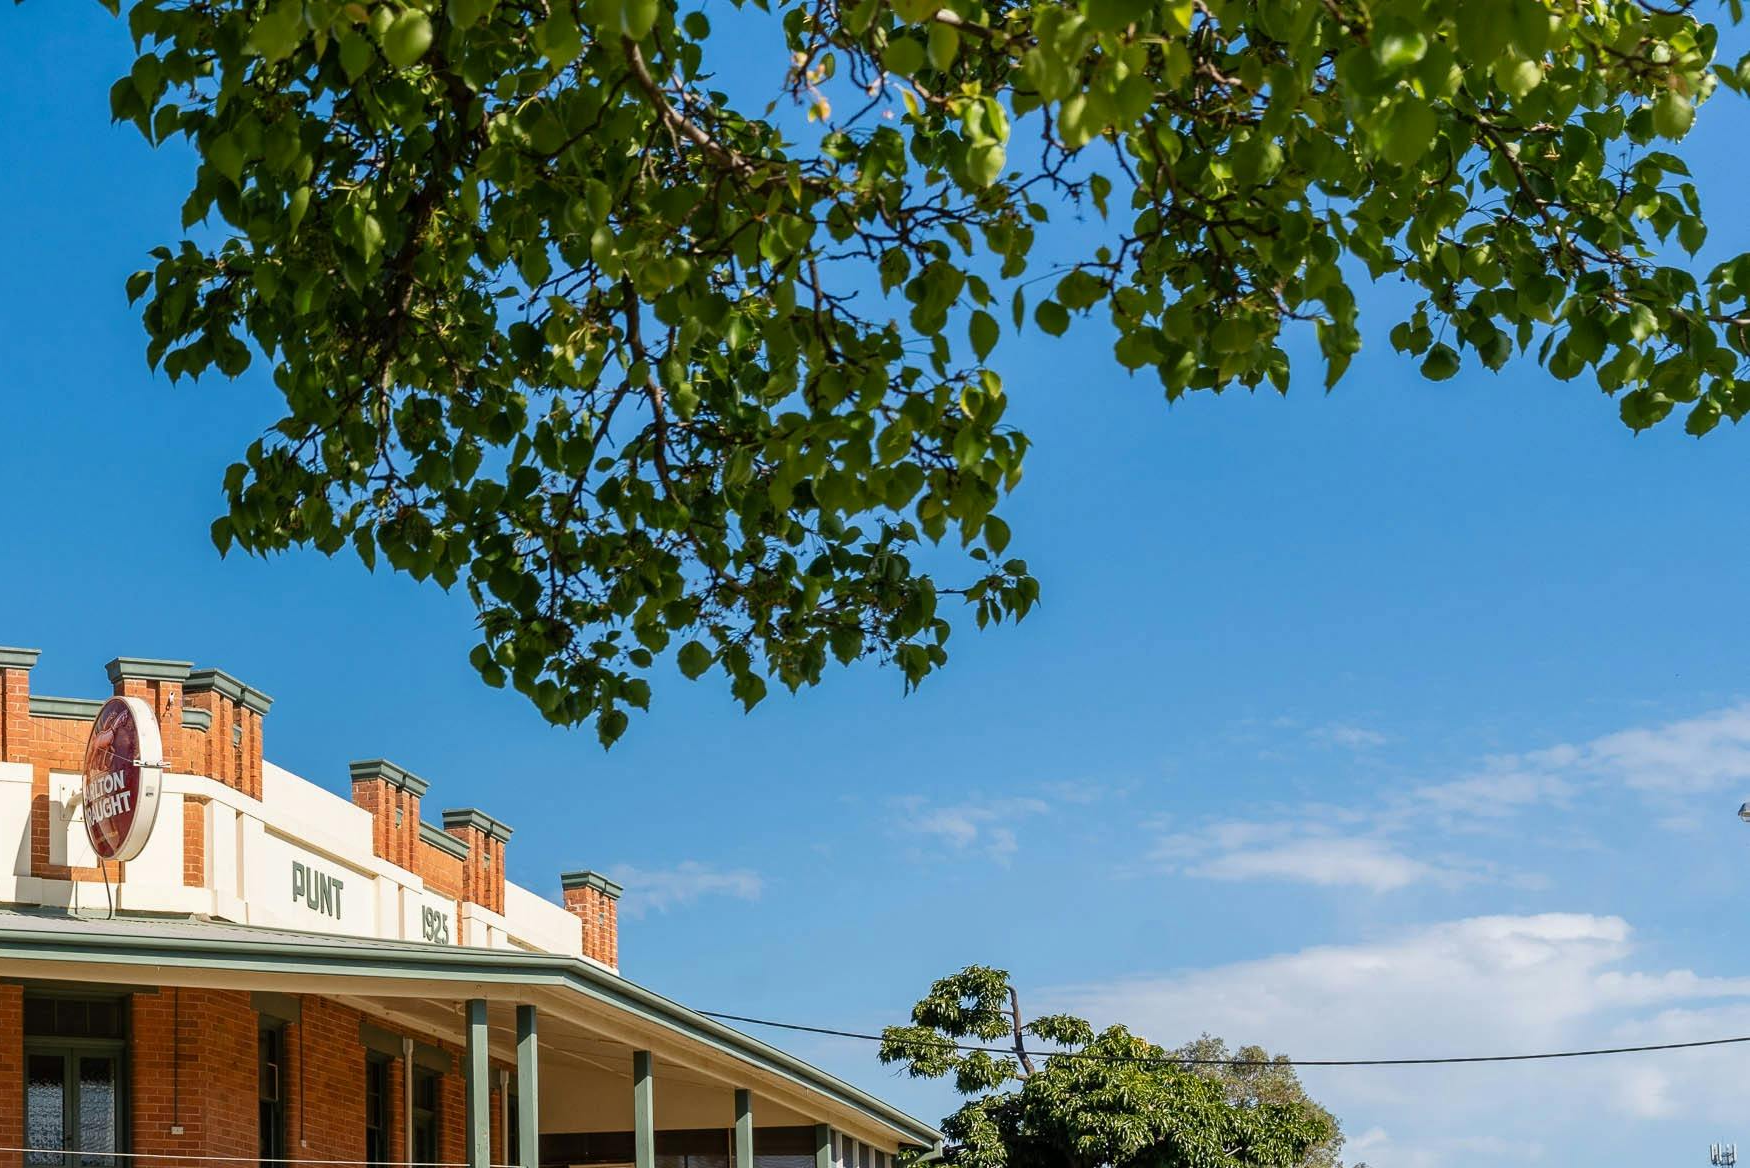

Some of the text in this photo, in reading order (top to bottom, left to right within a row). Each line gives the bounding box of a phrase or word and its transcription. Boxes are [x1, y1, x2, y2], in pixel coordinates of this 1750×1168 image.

[85, 770, 126, 805] ARLTON
[85, 790, 131, 828] RAUGHT
[292, 860, 344, 921] PUNT
[421, 904, 450, 945] 1925
